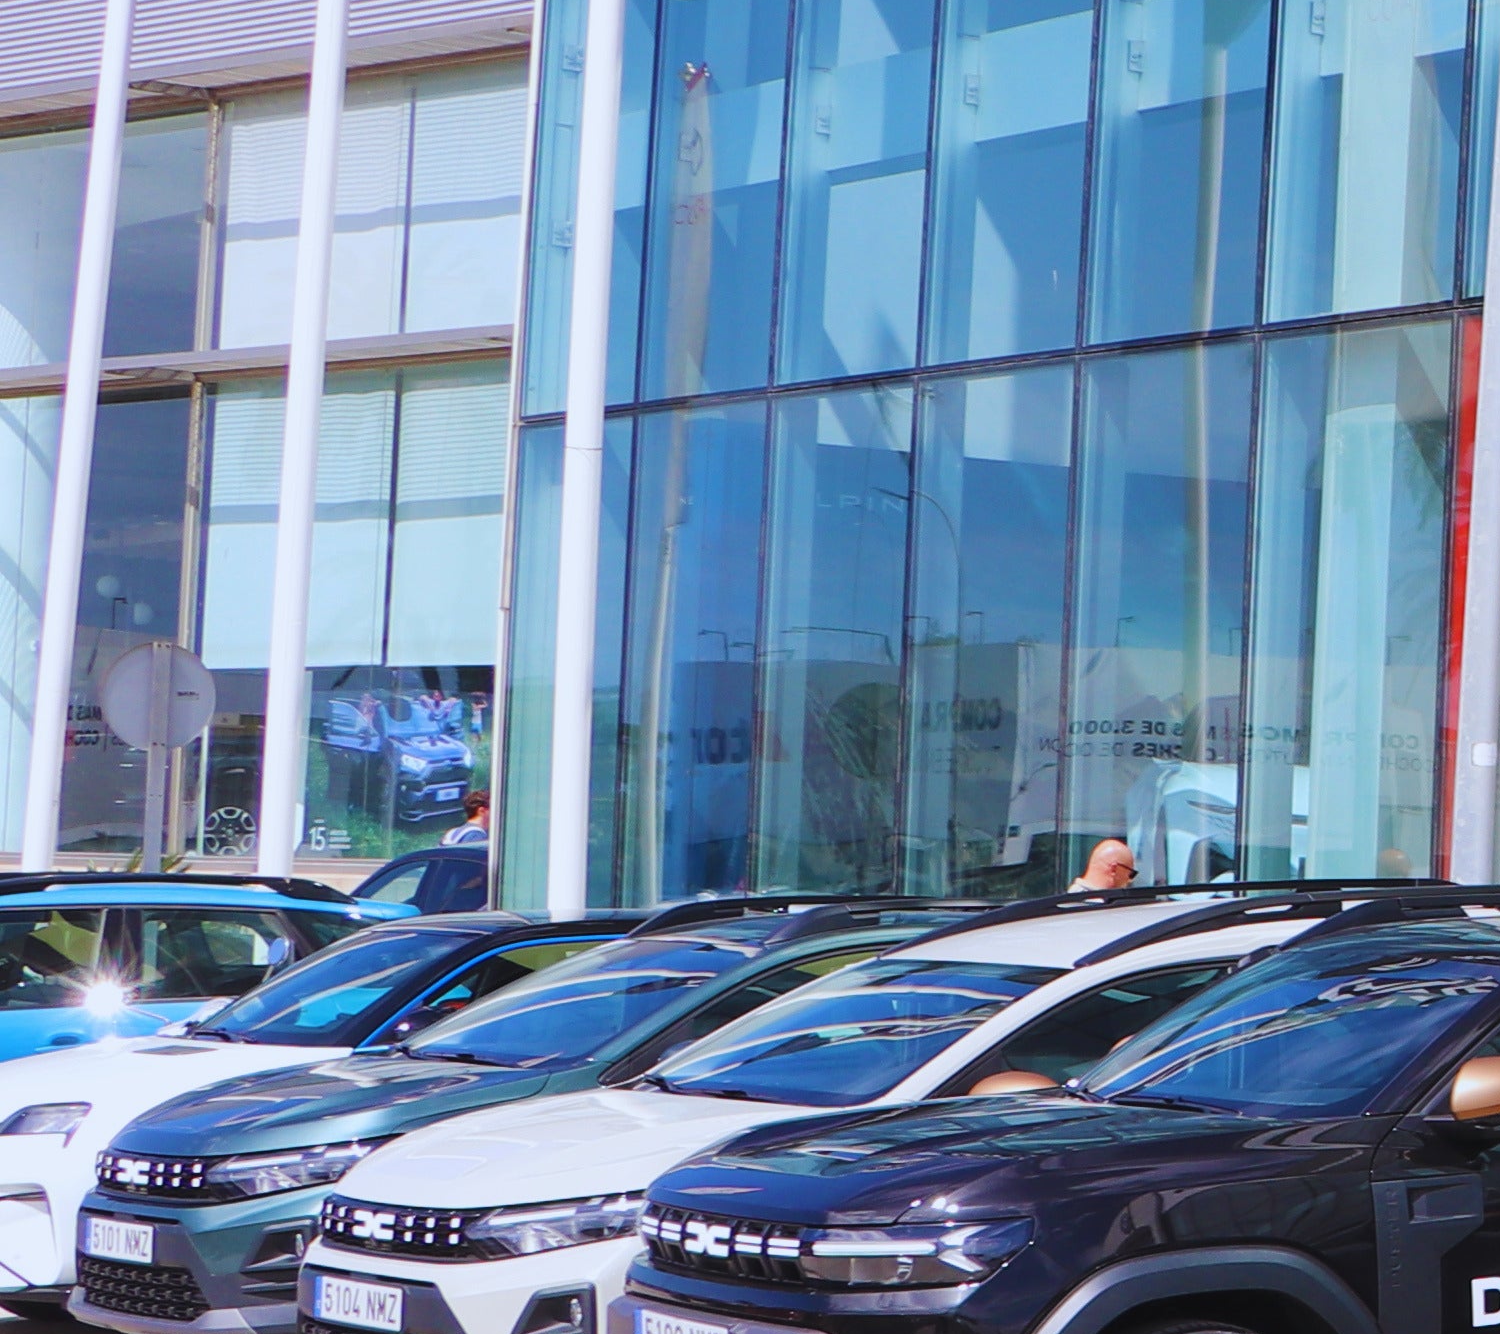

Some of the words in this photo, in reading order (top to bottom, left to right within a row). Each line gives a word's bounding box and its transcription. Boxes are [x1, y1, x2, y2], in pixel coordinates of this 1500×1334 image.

[308, 824, 327, 852] 15
[93, 1223, 121, 1253] 5101
[125, 1228, 149, 1257] NMZ
[324, 1282, 360, 1318] 5104
[366, 1289, 397, 1324] NMZ
